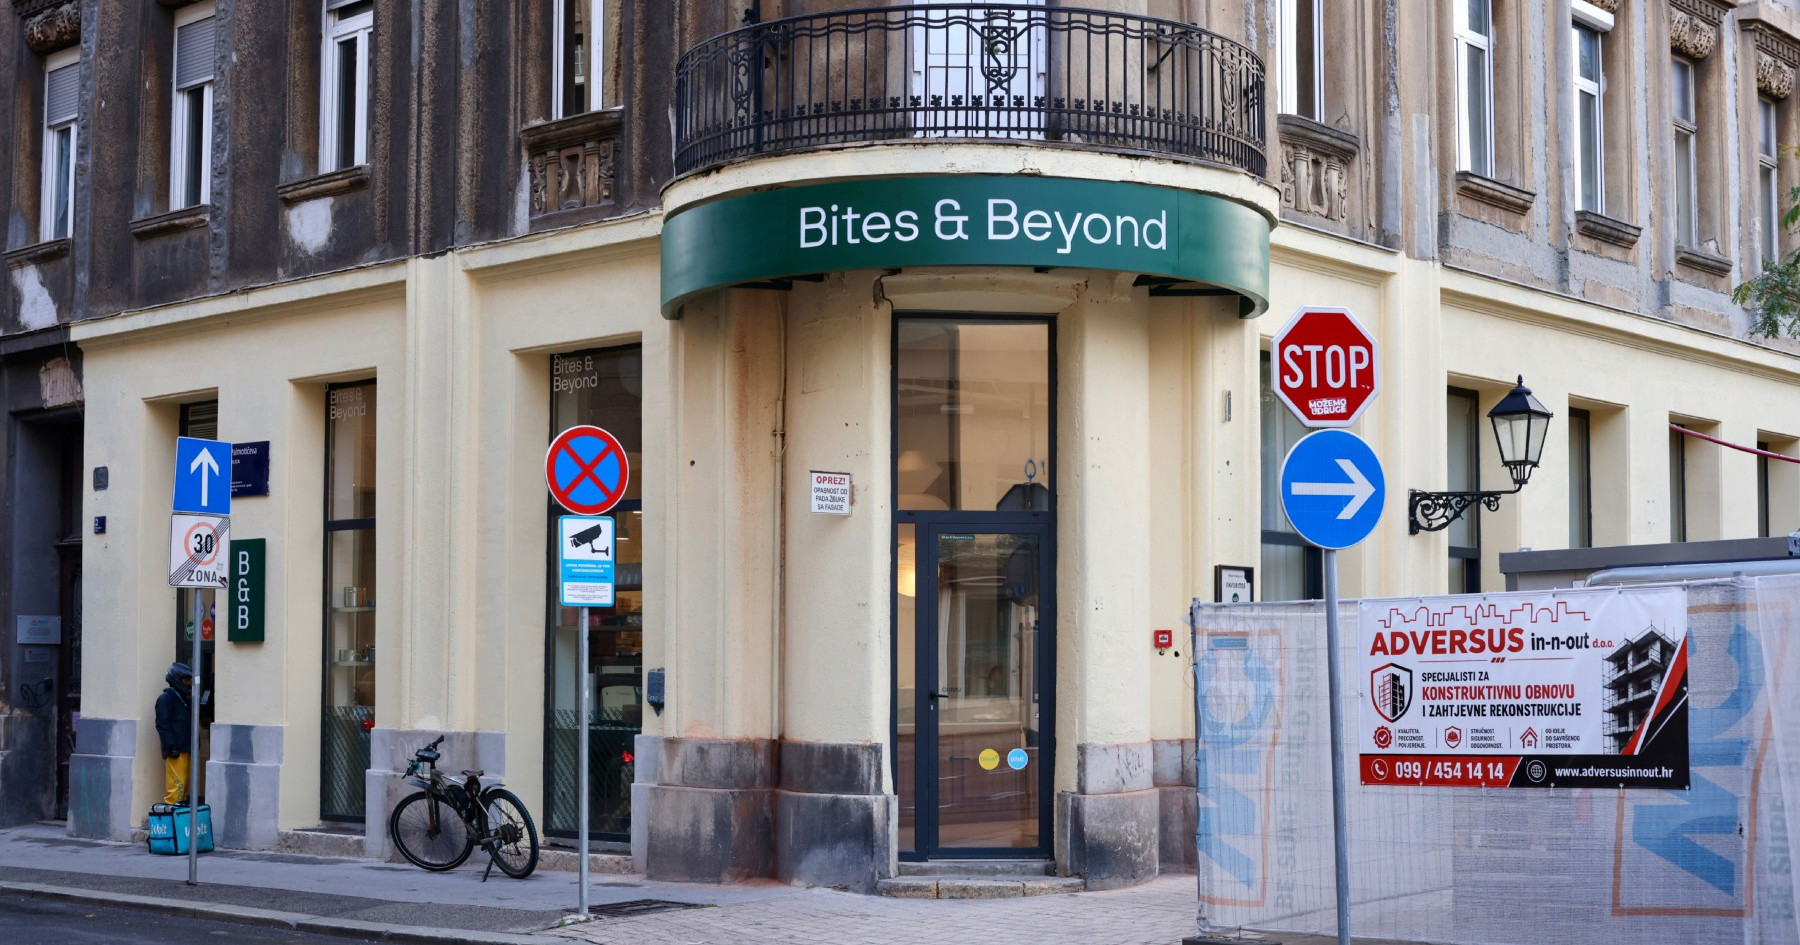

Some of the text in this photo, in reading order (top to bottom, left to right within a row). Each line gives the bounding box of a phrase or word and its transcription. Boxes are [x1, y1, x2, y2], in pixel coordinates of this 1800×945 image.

[799, 198, 1168, 254] Bites & Beyond
[553, 355, 594, 375] Bites &
[1283, 344, 1370, 389] STOP
[553, 371, 598, 394] Beyond
[330, 389, 354, 405] Bites
[1309, 398, 1347, 408] MOŽEMO
[330, 402, 366, 421] Beyond
[816, 475, 846, 485] OPREZ!
[813, 487, 839, 495] OPASNOST
[829, 494, 846, 503] ŽBUKE
[817, 503, 844, 511] SA FASADE
[193, 533, 214, 554] 30
[186, 570, 218, 583] ZONA
[237, 550, 251, 630] B&B
[1370, 627, 1615, 656] ADVERSUS in-n-out d.o.o.
[1421, 671, 1490, 682] SPECIJALISTI ZA
[1421, 683, 1575, 701] KONSTRUKTIVNU OBNOVU
[1422, 702, 1582, 718] I ZAHTJEVNE REKONSTRUKCIJE
[1553, 734, 1581, 742] SAVRŠENOG
[1274, 629, 1317, 911] BE SURE BUILD SURE
[1395, 760, 1504, 780] 099 / 454 14 14
[1554, 765, 1674, 778] www.adversusinnout.hr
[151, 823, 168, 835] Wolt
